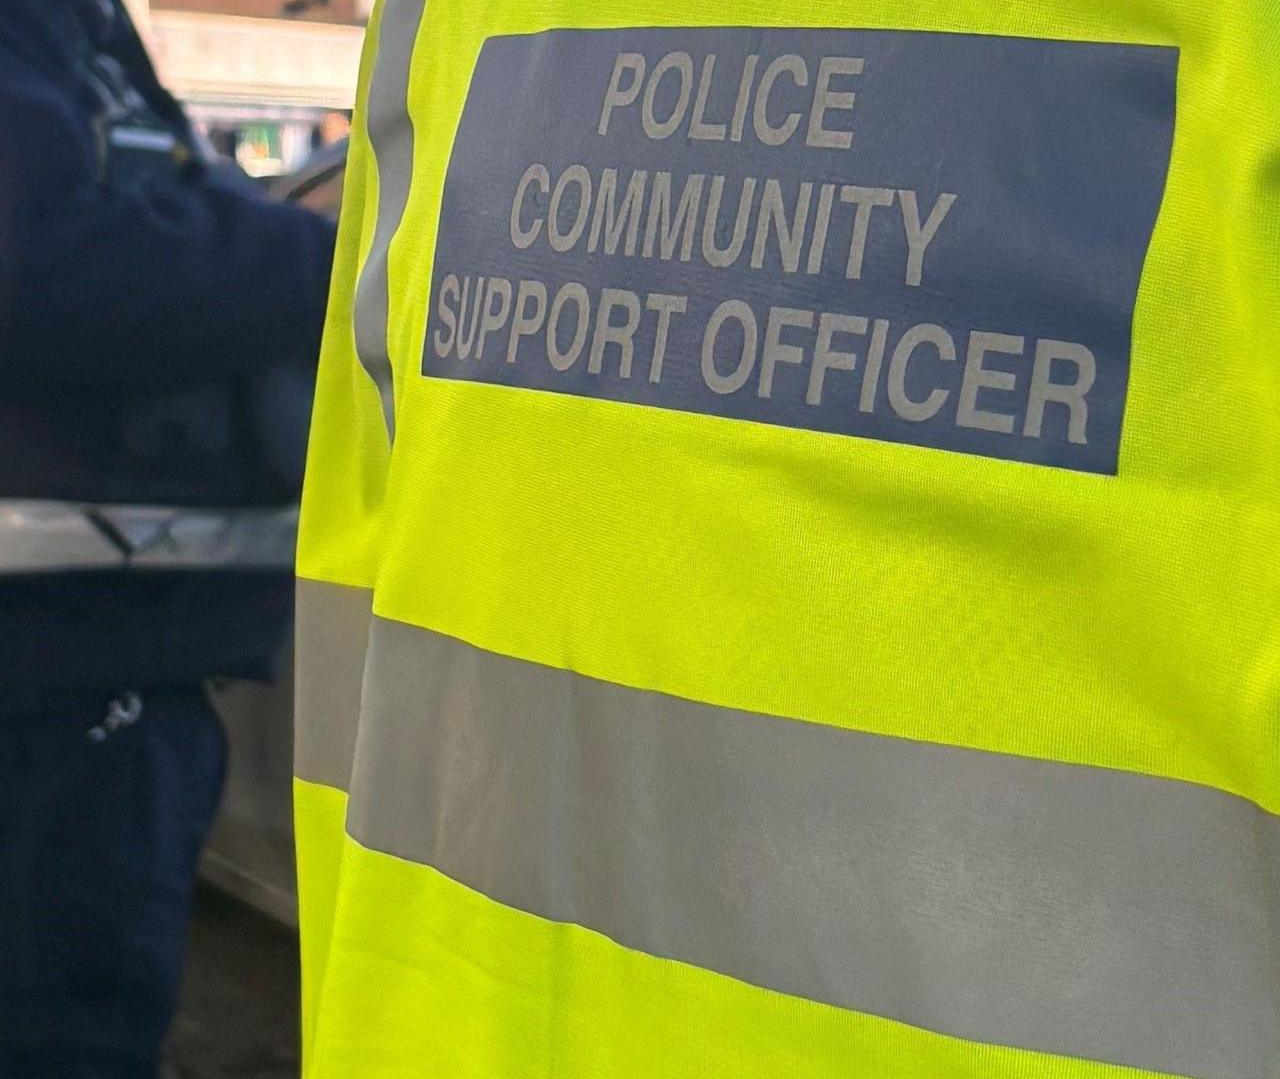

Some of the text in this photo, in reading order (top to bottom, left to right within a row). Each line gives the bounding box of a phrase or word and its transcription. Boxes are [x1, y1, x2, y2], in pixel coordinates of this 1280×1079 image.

[596, 50, 866, 150] POLICE
[509, 162, 958, 288] COMMUNITY
[432, 274, 1096, 445] SUPPORT OFFICER
